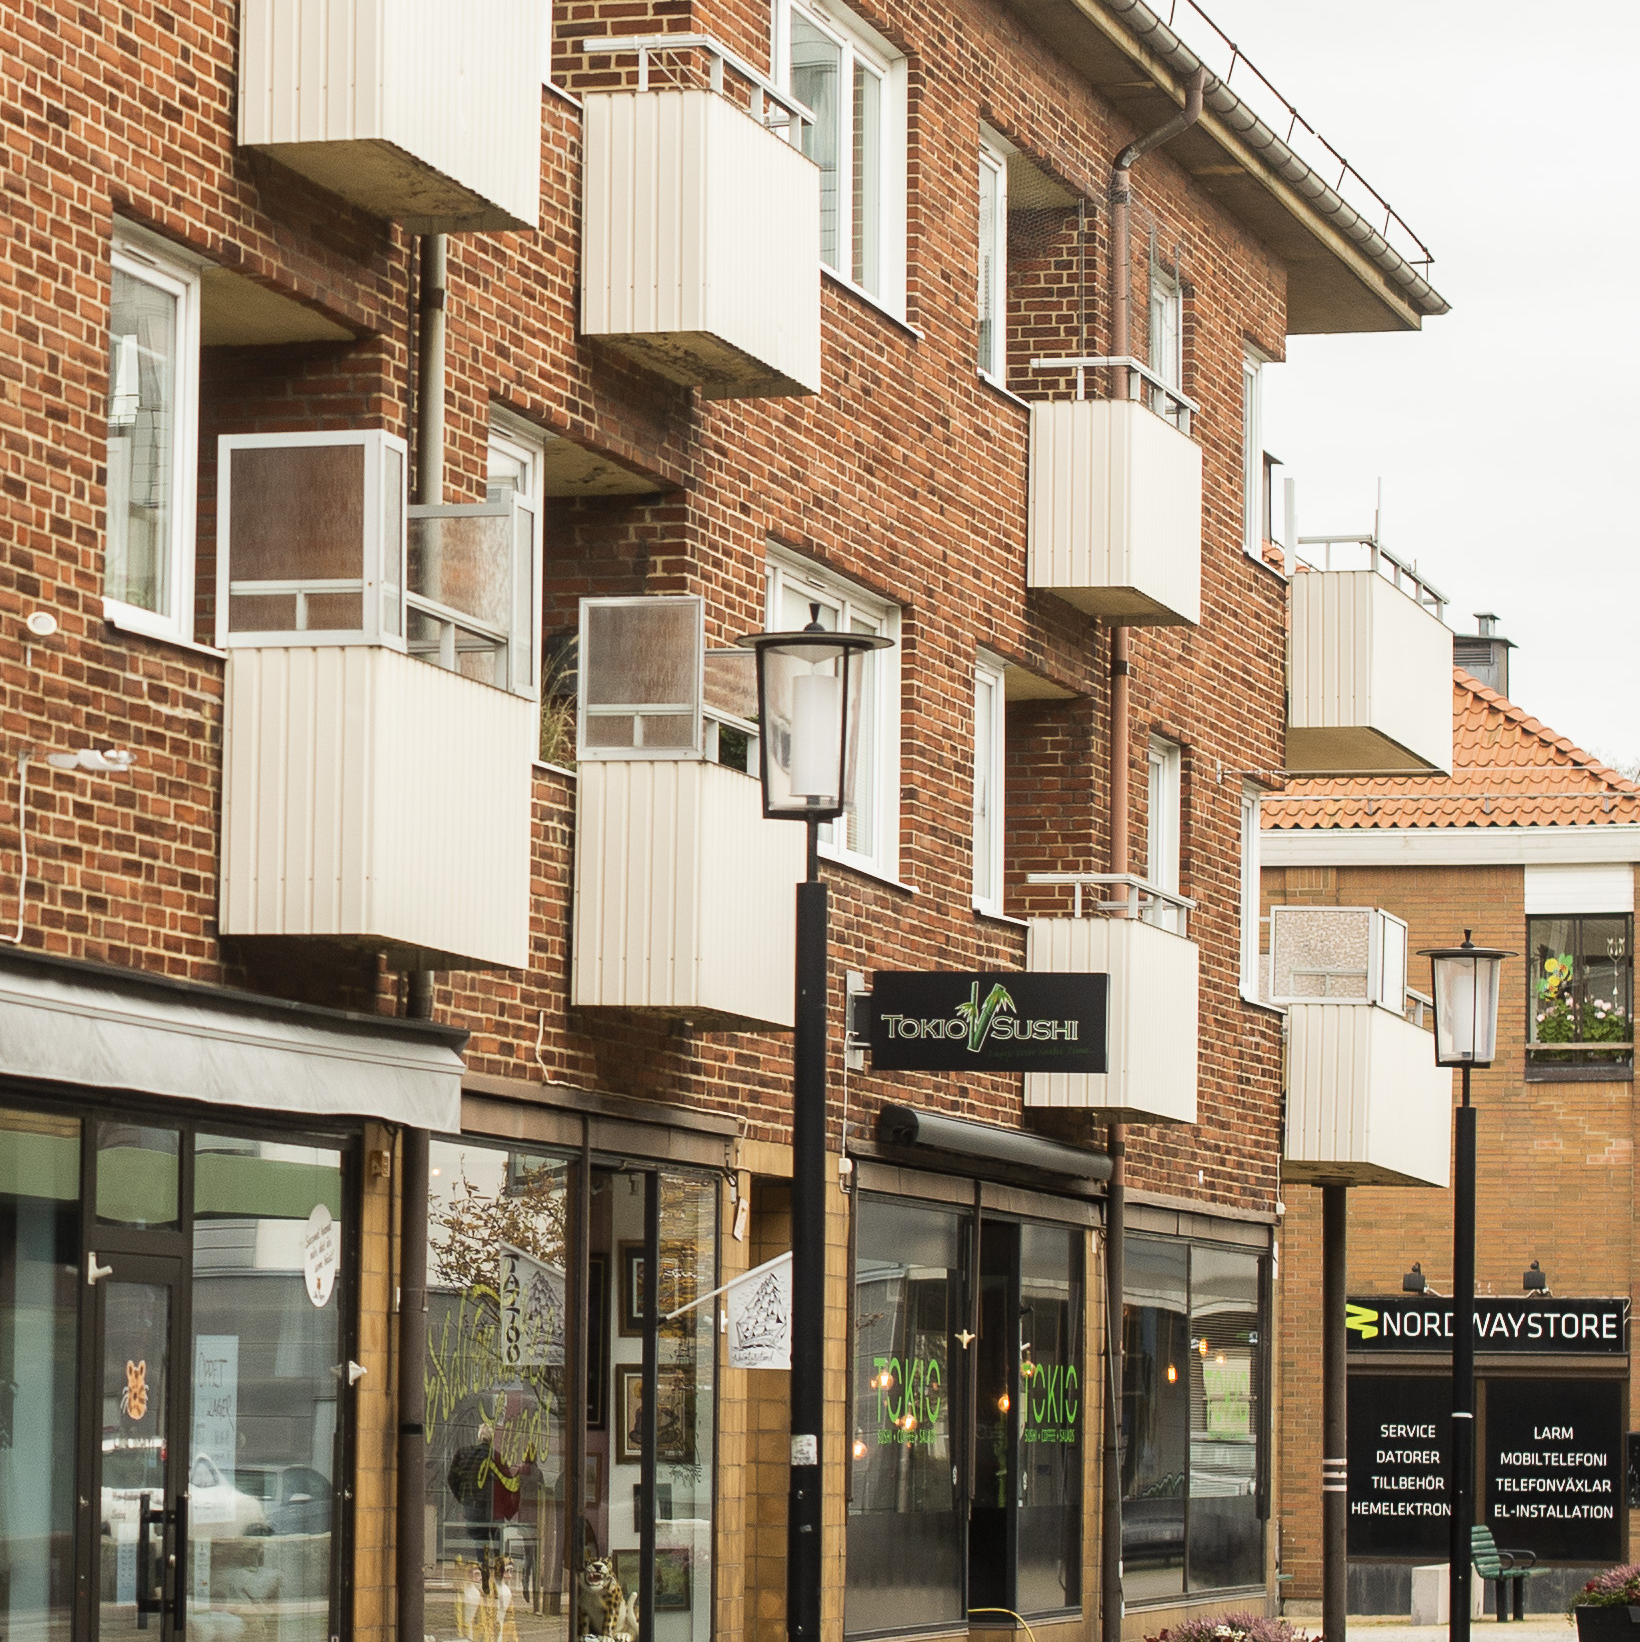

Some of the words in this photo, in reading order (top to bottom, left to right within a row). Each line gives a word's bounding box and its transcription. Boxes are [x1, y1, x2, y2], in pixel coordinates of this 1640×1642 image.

[881, 1013, 968, 1039] TOKIO
[990, 1015, 1079, 1041] SUSHI
[503, 1253, 521, 1363] TATTOO
[873, 1357, 941, 1424] TOKIO
[1022, 1363, 1078, 1424] TOKIO
[1380, 1424, 1436, 1438] SERVICE
[1534, 1426, 1574, 1440] LARM
[1376, 1450, 1440, 1464] DATORER
[1500, 1452, 1607, 1467] MOBILTELEFONI
[1371, 1474, 1445, 1490] TILLBEHÖR
[1495, 1475, 1612, 1493] TELEFONVÄXLAR
[1494, 1504, 1614, 1519] EL-INSTALLATION
